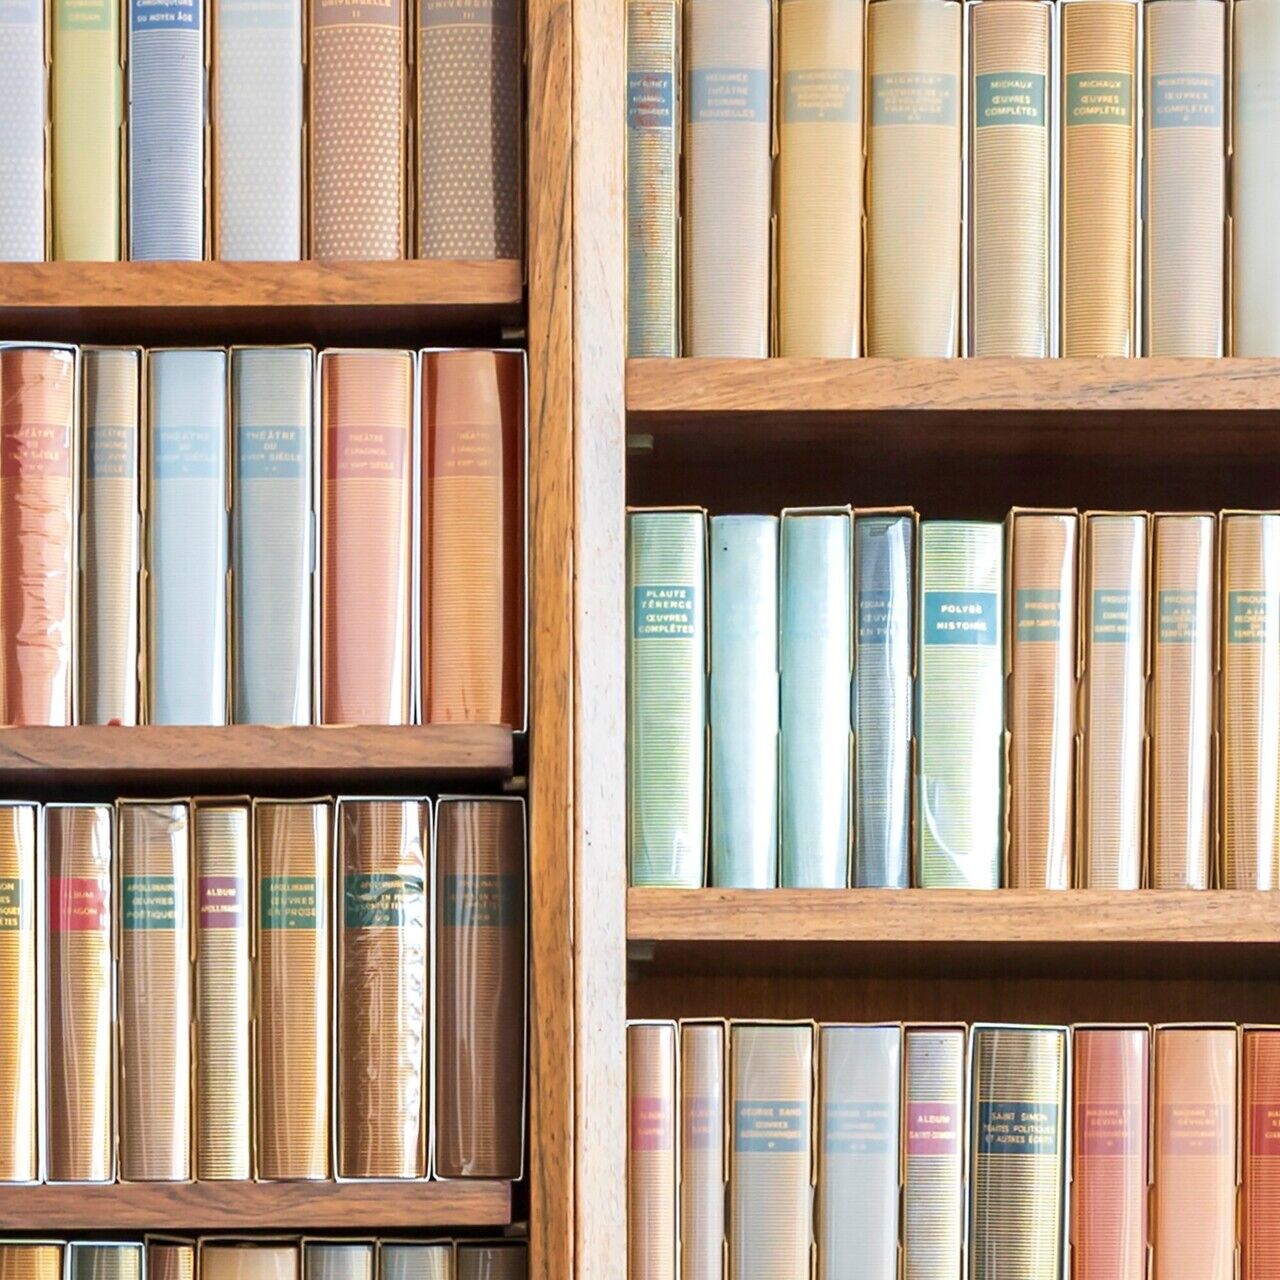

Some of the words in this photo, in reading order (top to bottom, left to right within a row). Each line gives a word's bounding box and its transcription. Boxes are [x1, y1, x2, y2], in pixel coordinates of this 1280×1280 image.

[991, 80, 1033, 89] MICHAUX
[1078, 80, 1121, 89] MICHAUX
[991, 95, 1031, 105] ŒUVRES
[247, 429, 296, 440] THÉÂTRE
[263, 442, 277, 450] DU
[646, 590, 687, 598] PLAUTE
[641, 600, 693, 609] TÉRENCE
[940, 604, 983, 614] POLYBE
[646, 614, 688, 623] ŒUVRES
[638, 624, 695, 634] COMPLÈTES
[936, 621, 988, 632] HISTOIRE
[917, 1114, 951, 1124] ALBUM
